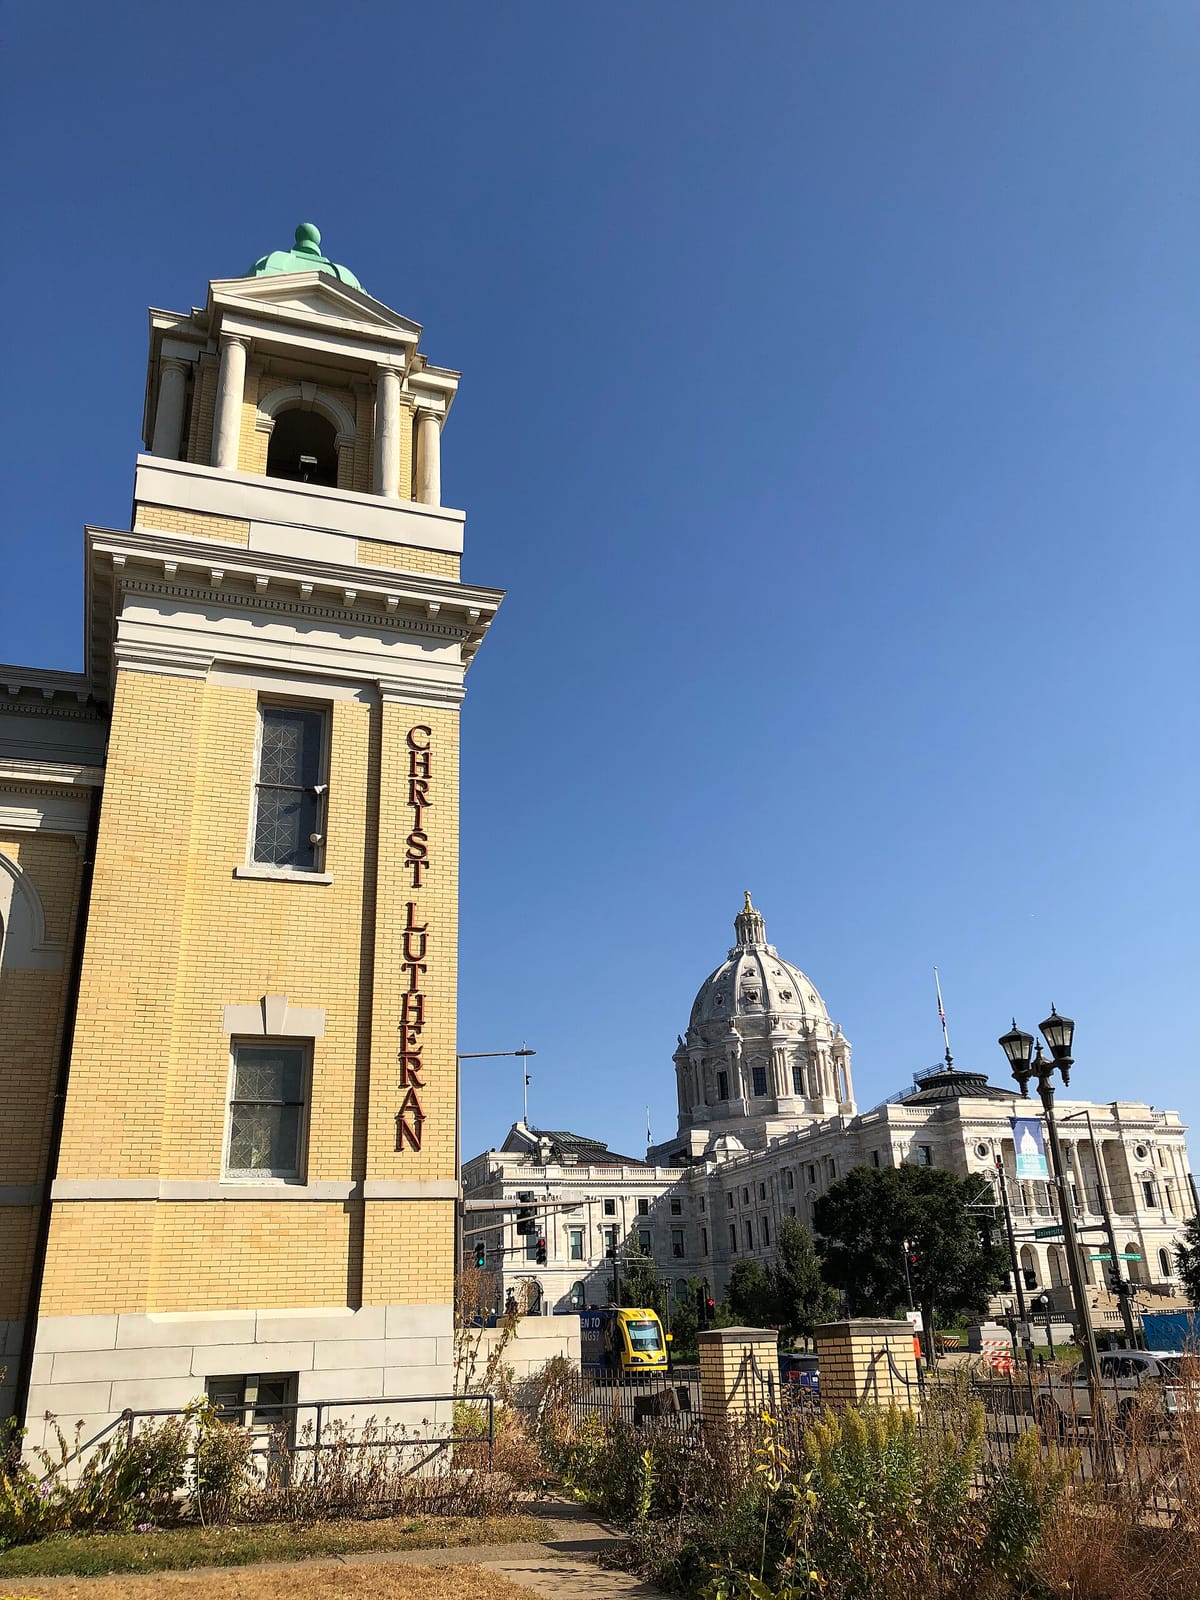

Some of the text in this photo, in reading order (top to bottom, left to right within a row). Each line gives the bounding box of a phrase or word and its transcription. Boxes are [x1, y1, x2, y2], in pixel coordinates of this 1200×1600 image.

[393, 724, 433, 1152] CHRIST LUTHERAN
[591, 1317, 601, 1328] TO
